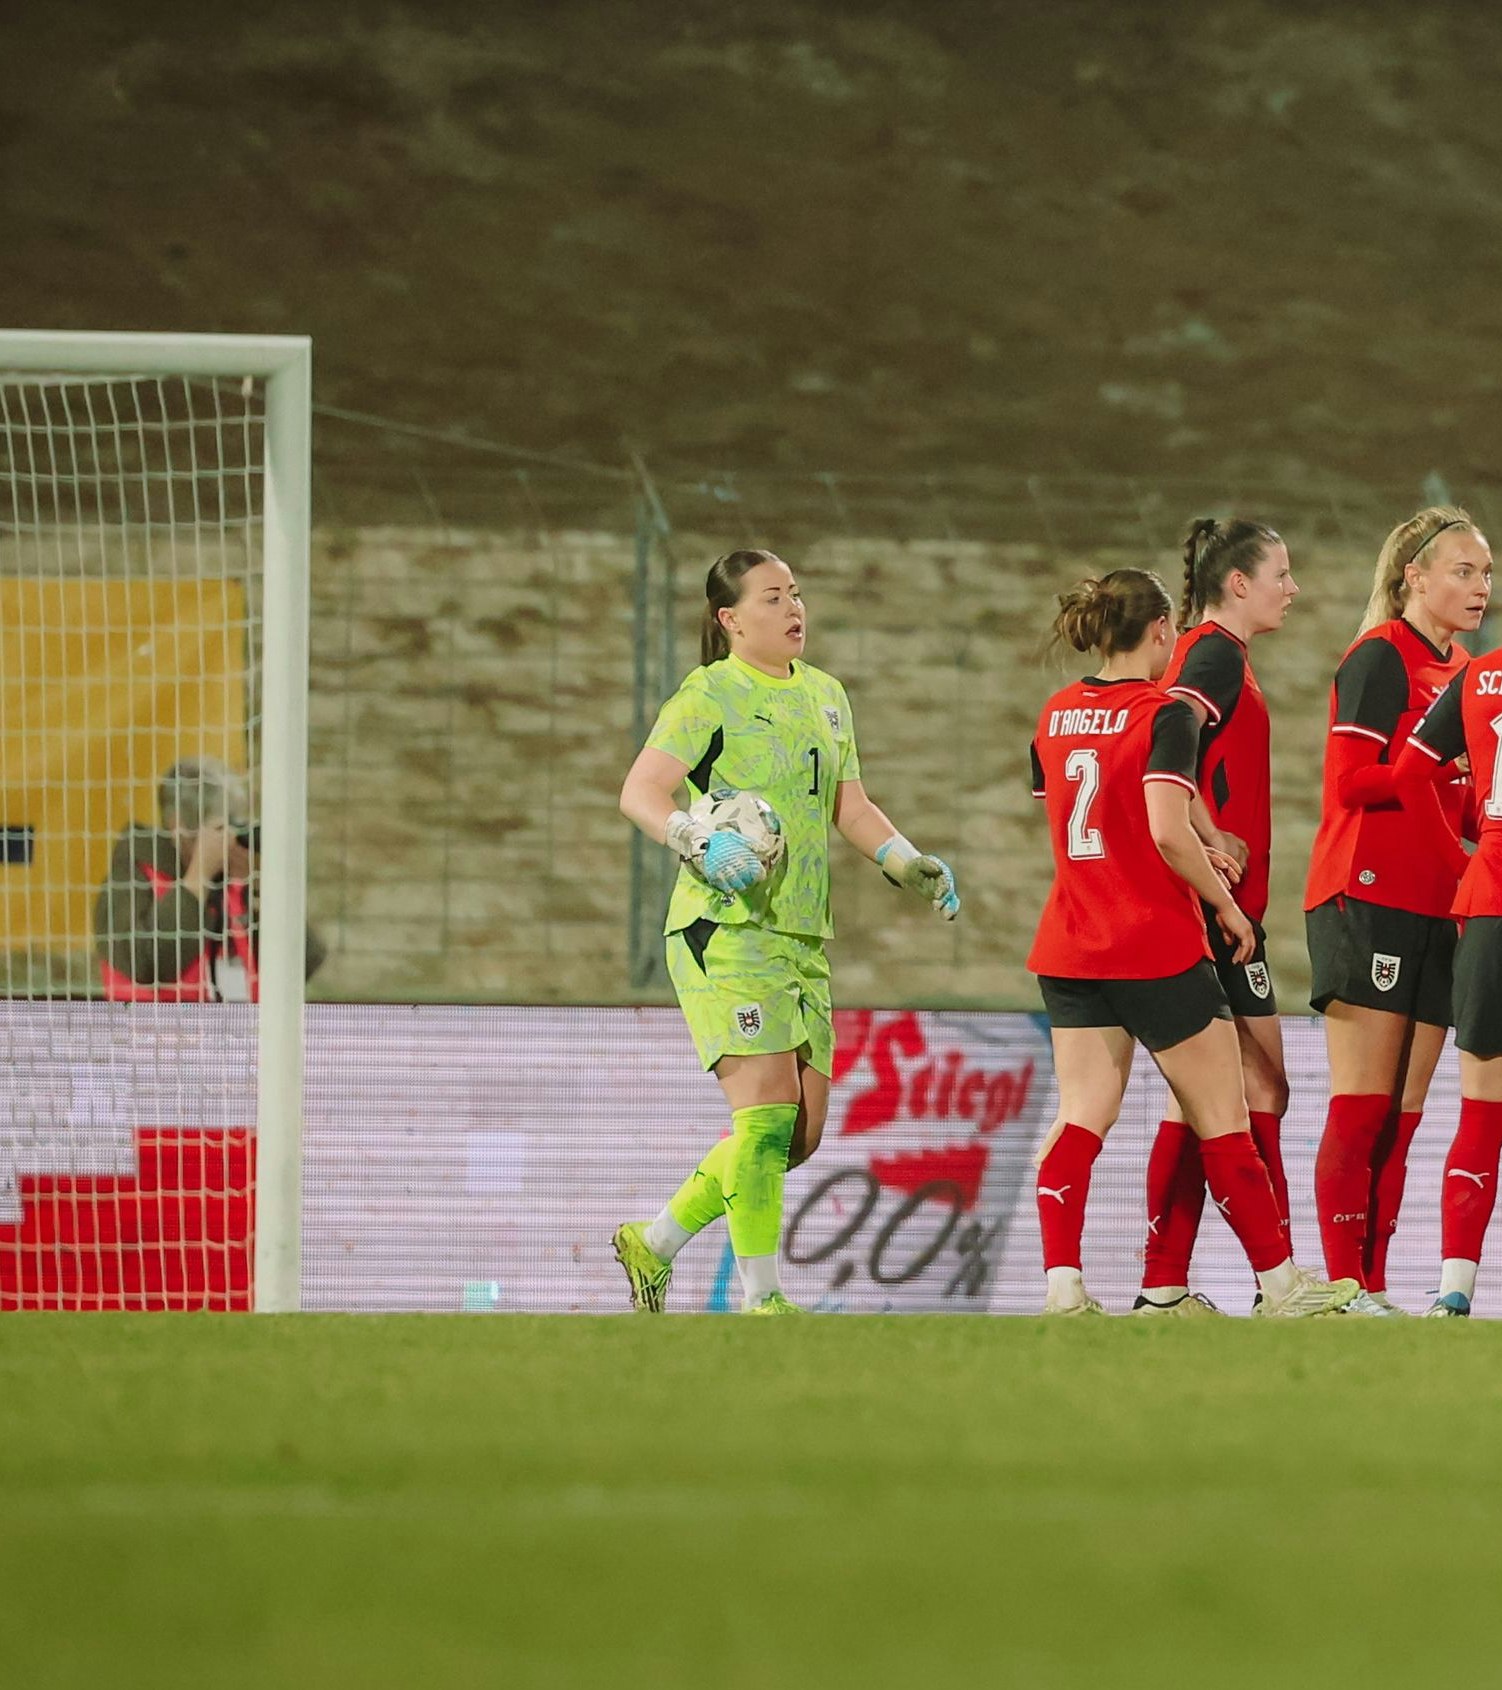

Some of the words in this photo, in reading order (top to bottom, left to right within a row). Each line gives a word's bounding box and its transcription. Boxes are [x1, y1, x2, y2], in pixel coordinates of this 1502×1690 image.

[1048, 708, 1130, 738] D'ANGELO
[808, 747, 819, 796] 1
[1064, 748, 1106, 860] 2
